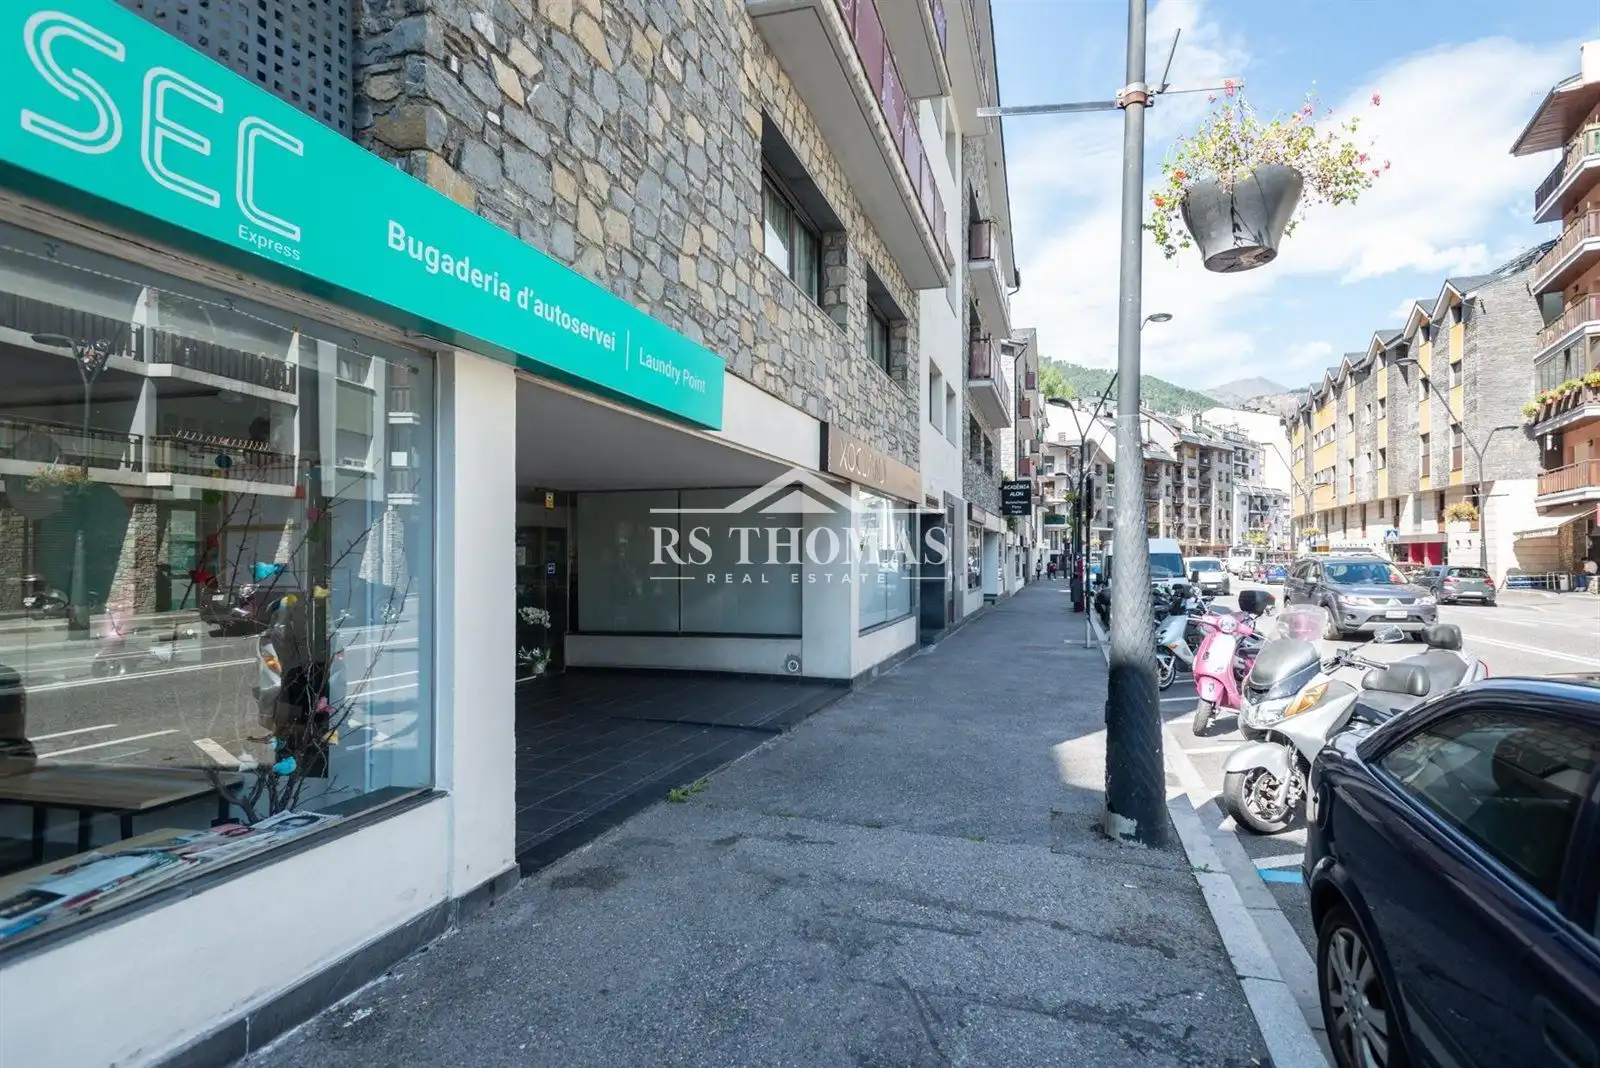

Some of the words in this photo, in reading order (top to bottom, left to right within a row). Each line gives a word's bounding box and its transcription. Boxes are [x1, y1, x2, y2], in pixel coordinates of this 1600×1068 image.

[21, 11, 304, 241] SEC
[238, 224, 301, 261] Express
[388, 220, 511, 301] Bugaderia
[516, 286, 616, 351] d'autoservei
[639, 346, 681, 385] Laundry
[683, 368, 706, 393] Point
